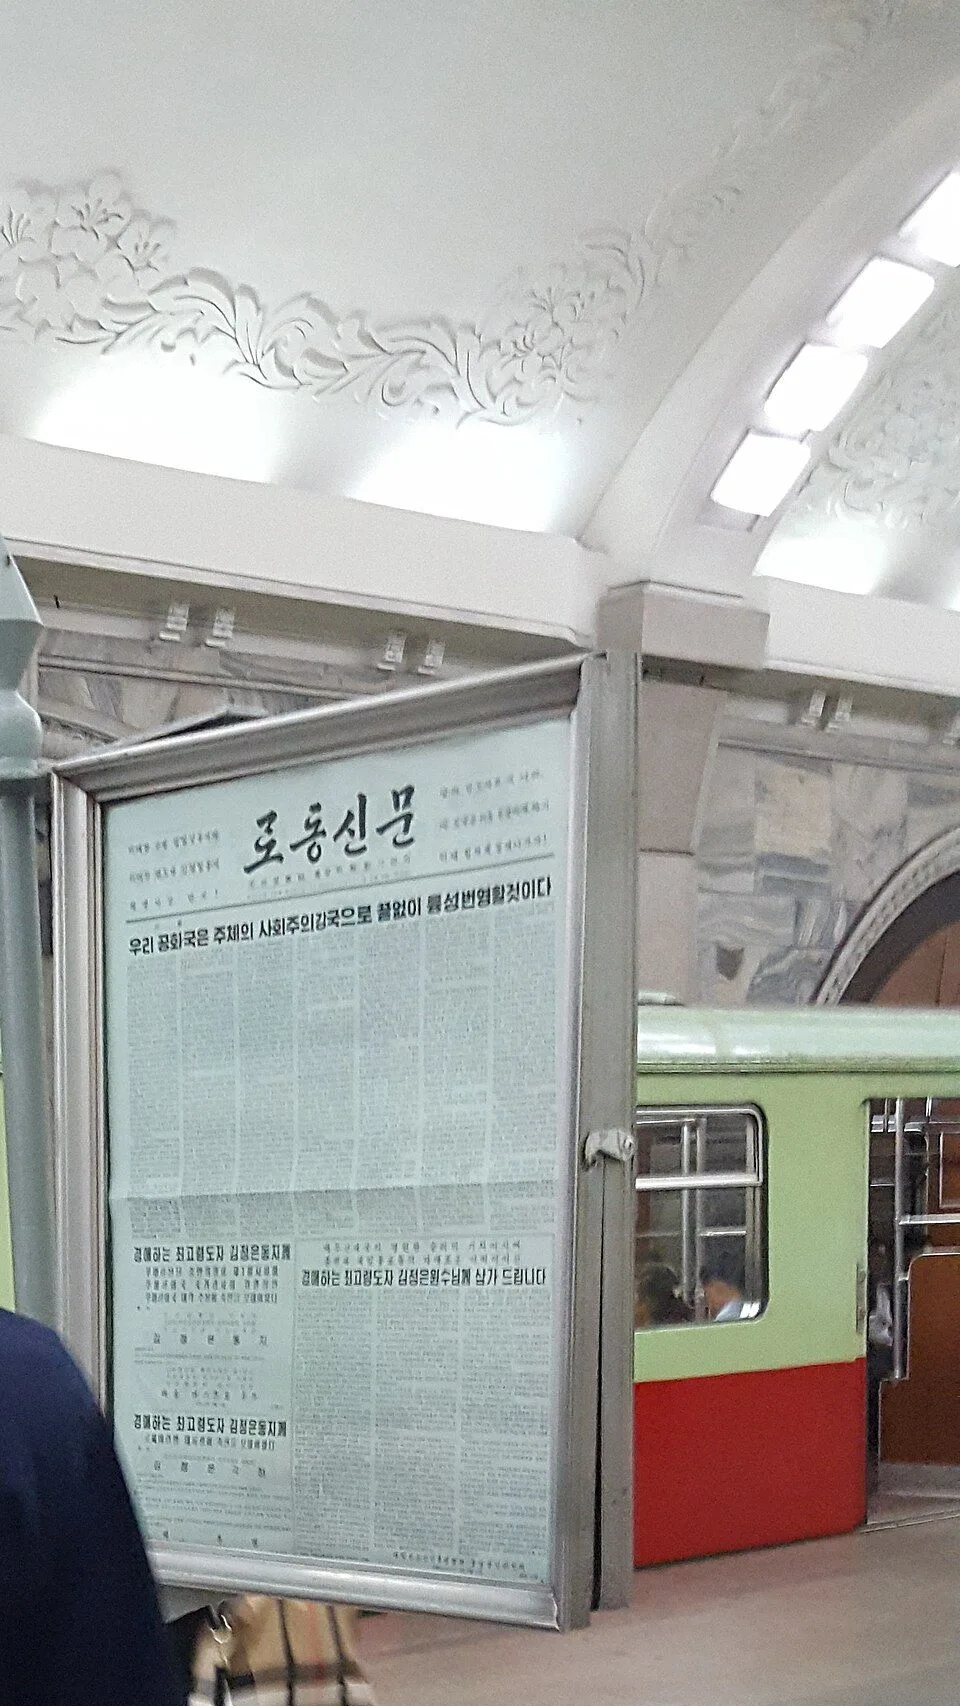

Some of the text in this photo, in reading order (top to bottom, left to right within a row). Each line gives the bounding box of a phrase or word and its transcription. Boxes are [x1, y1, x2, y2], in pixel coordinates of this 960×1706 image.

[243, 784, 416, 875] 로동신문
[129, 935, 154, 955] 우리
[157, 928, 209, 951] 공화국은
[213, 921, 254, 944] 주체의
[259, 904, 372, 937] 사회주의강국으로
[133, 1243, 291, 1263] 경애하는 최고령도자 김정은동지께
[301, 1267, 547, 1287] 경애하는 최고령도자 김정은원수님께 삼가 드립니다
[133, 1413, 287, 1437] 경애하는 최고령도자 김정은동지께
